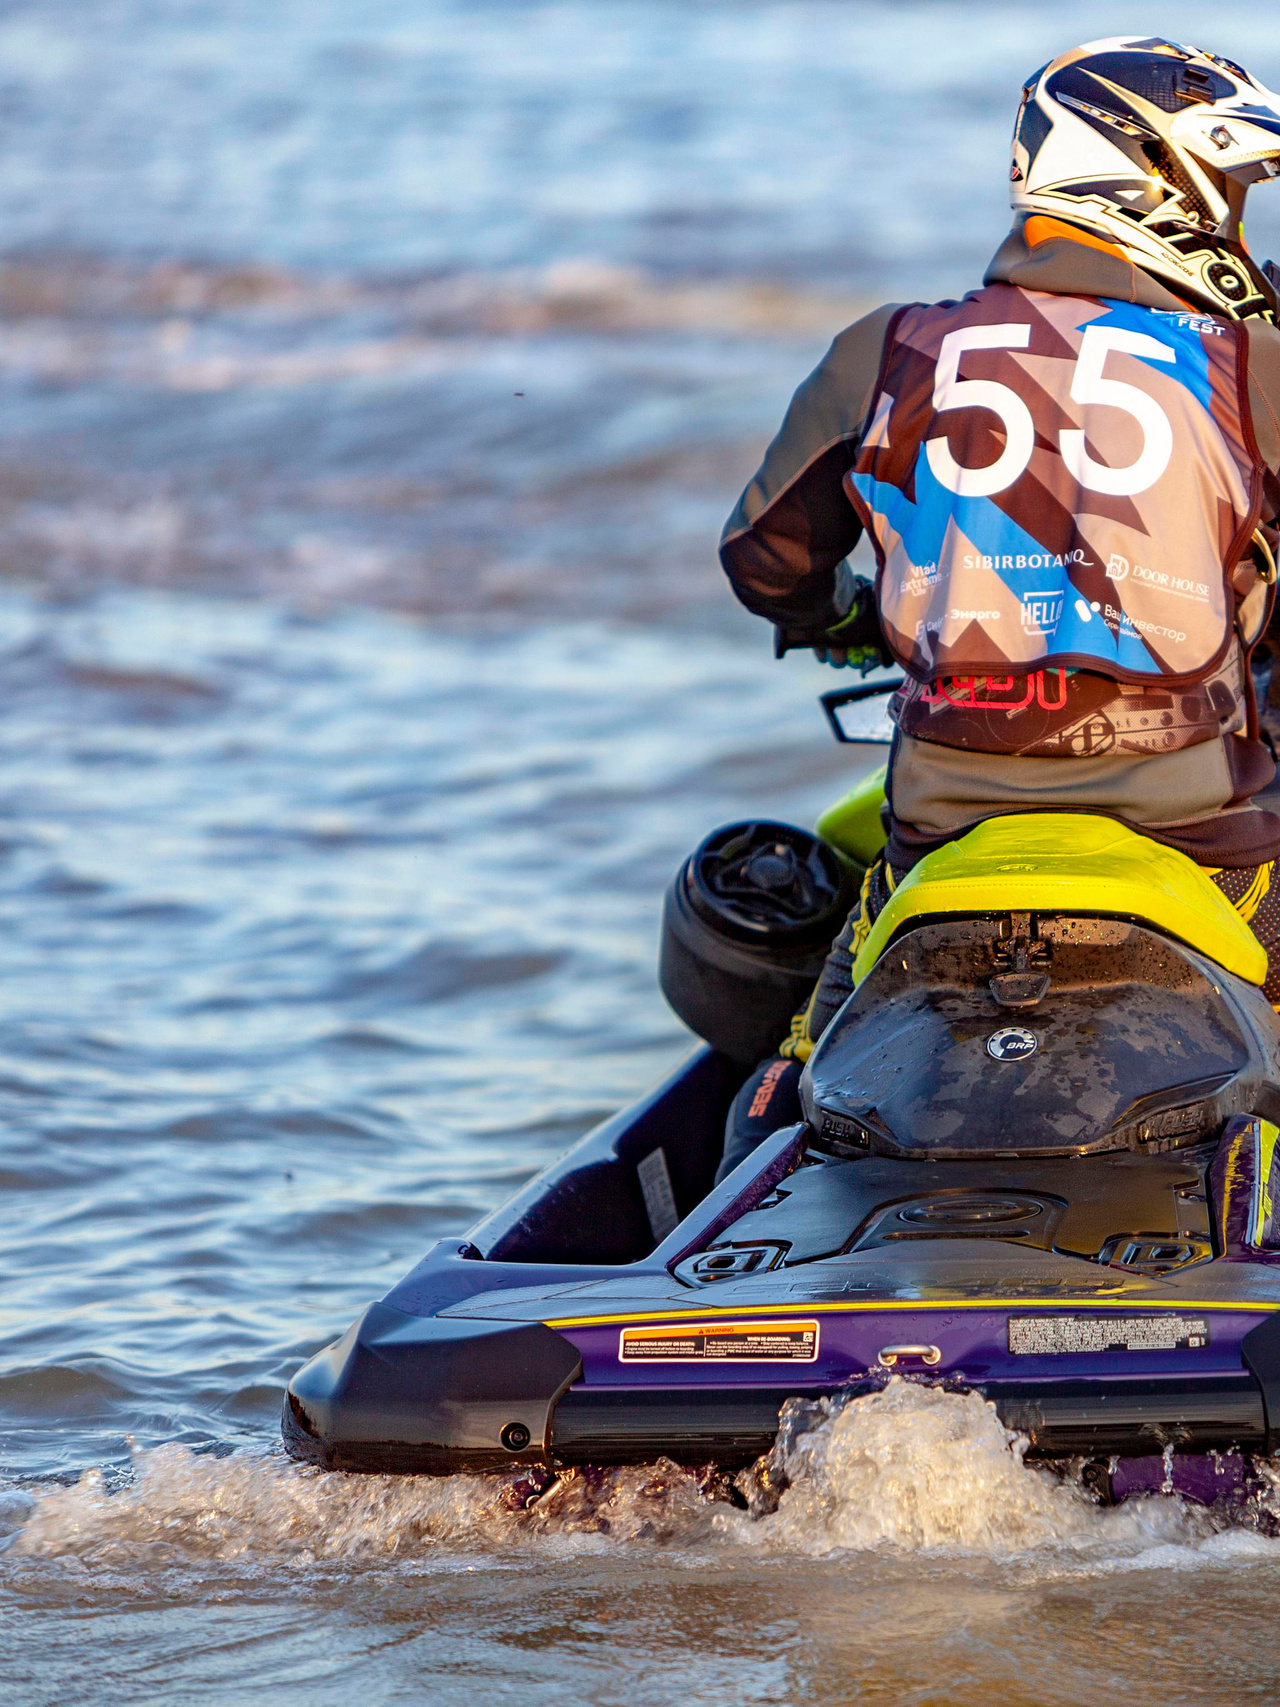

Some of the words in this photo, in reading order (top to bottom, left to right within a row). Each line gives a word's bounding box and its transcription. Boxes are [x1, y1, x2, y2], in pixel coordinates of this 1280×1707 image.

[1178, 318, 1225, 336] FEST
[925, 322, 1177, 498] 55
[962, 548, 1094, 569] SIBIRBOTANIQ
[910, 561, 937, 578] Vlad
[900, 573, 942, 593] Extreme
[1132, 564, 1169, 585] DOOR
[1170, 576, 1210, 597] HOUSE
[950, 608, 1001, 621] Энерго
[1122, 615, 1187, 644] инвестор
[705, 1327, 734, 1335] WARNING
